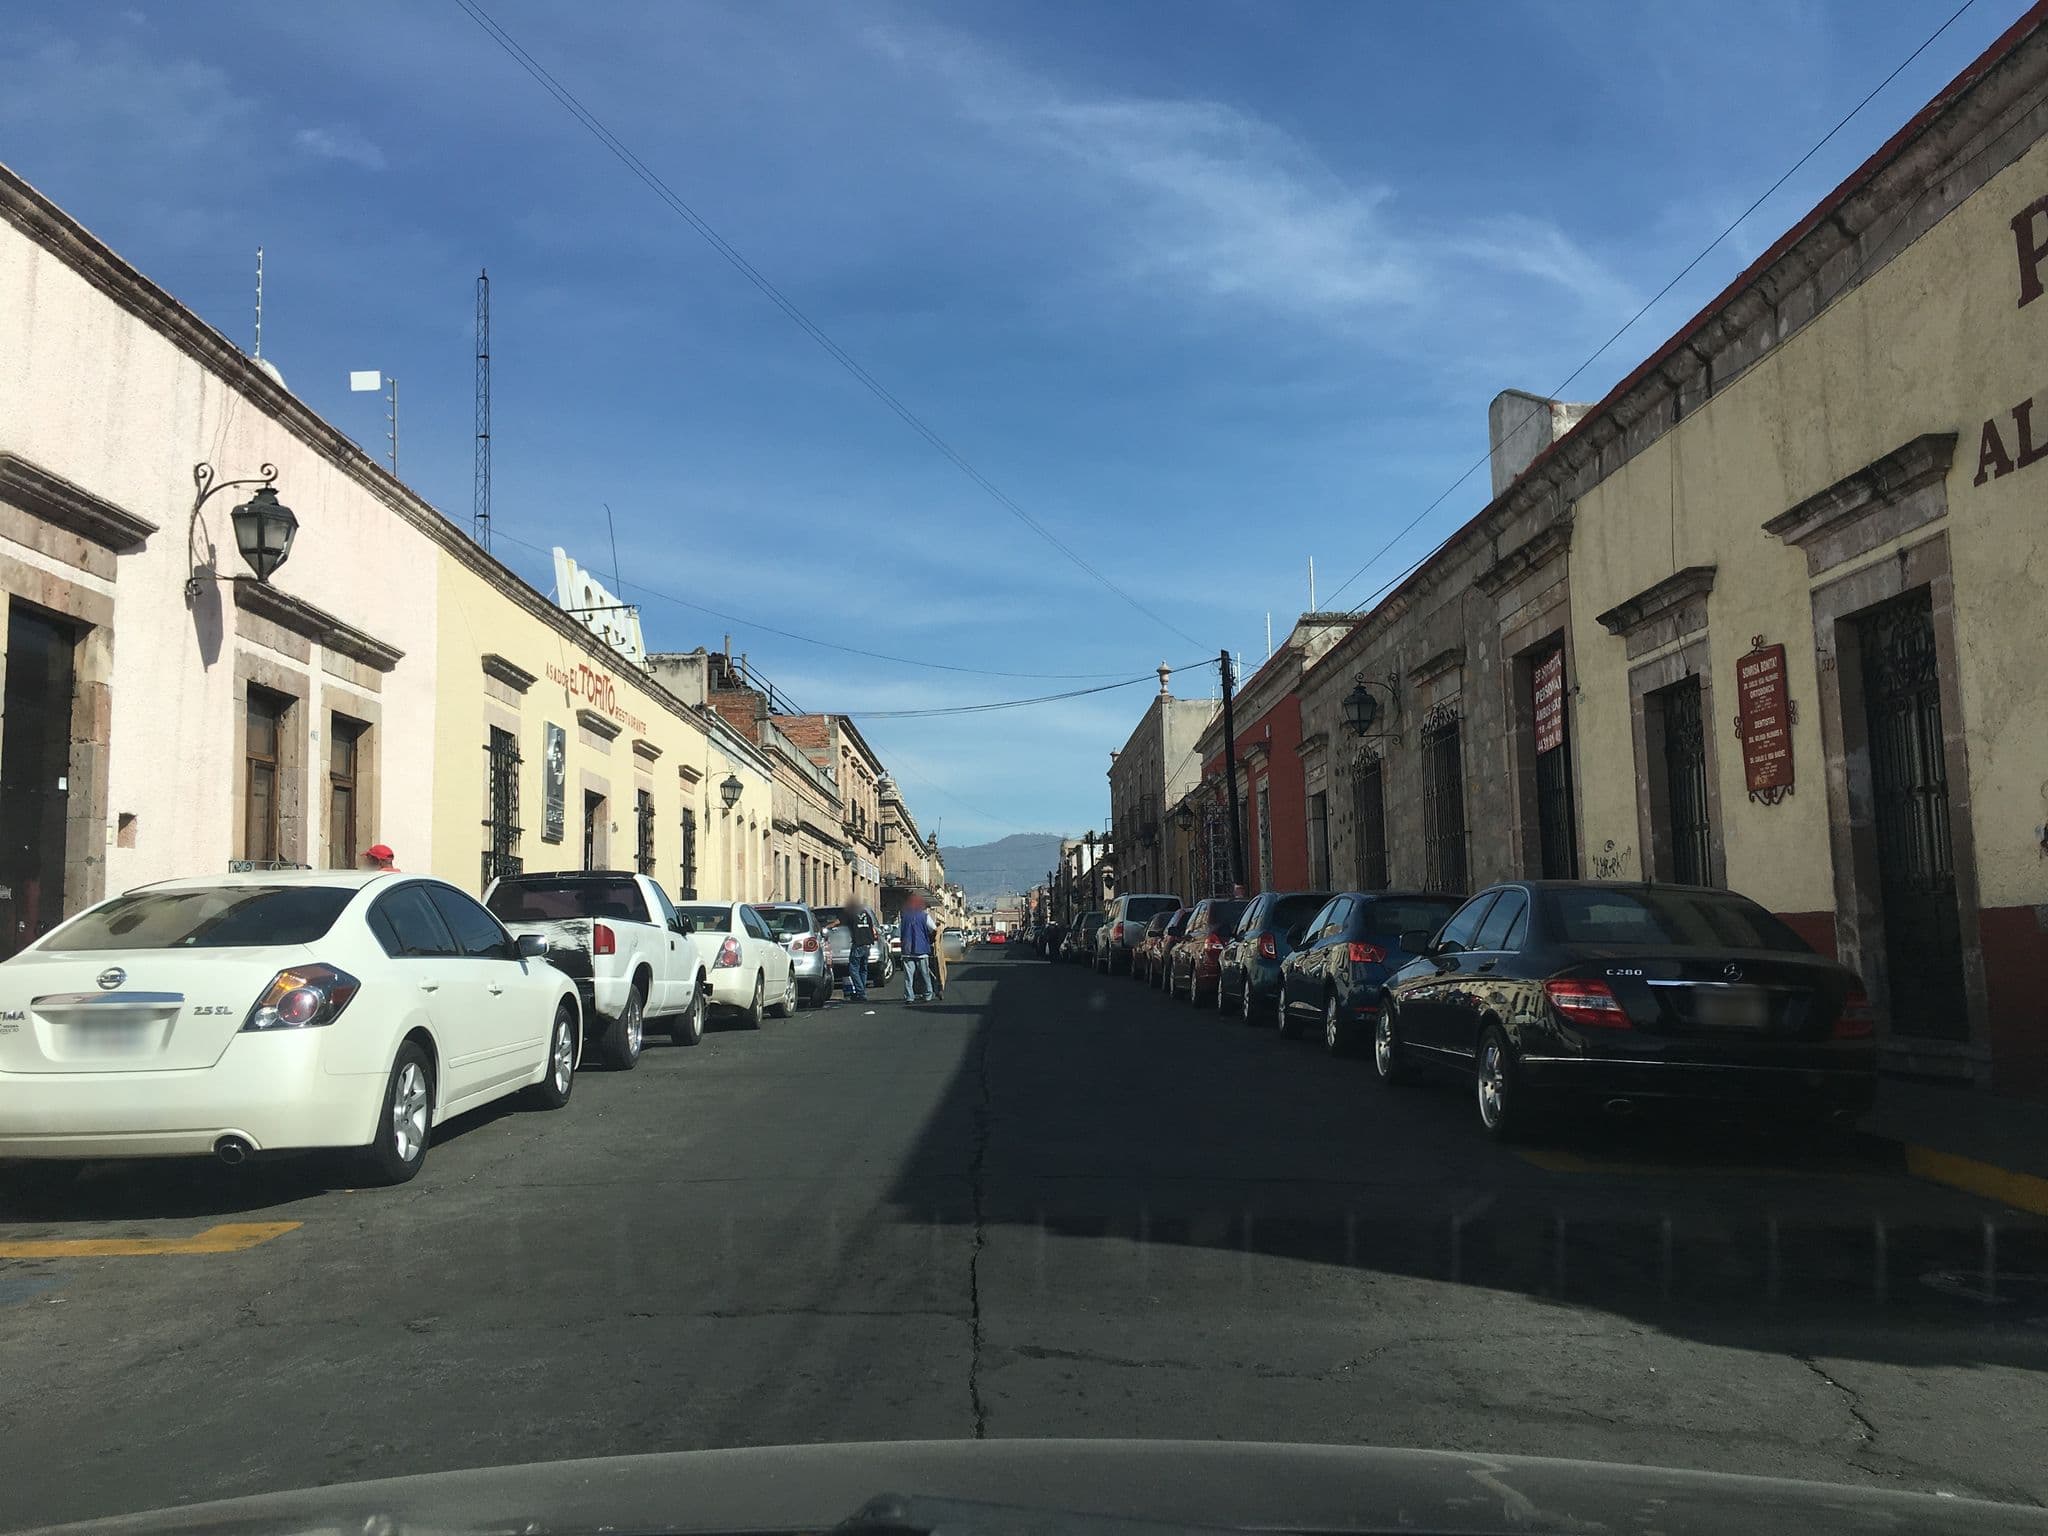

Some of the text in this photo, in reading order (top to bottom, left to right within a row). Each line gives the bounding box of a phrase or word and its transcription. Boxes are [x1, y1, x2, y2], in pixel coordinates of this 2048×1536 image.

[546, 661, 569, 689] ASADOR
[569, 667, 579, 696] EL
[578, 663, 615, 716] TORITO
[214, 1005, 234, 1016] SL
